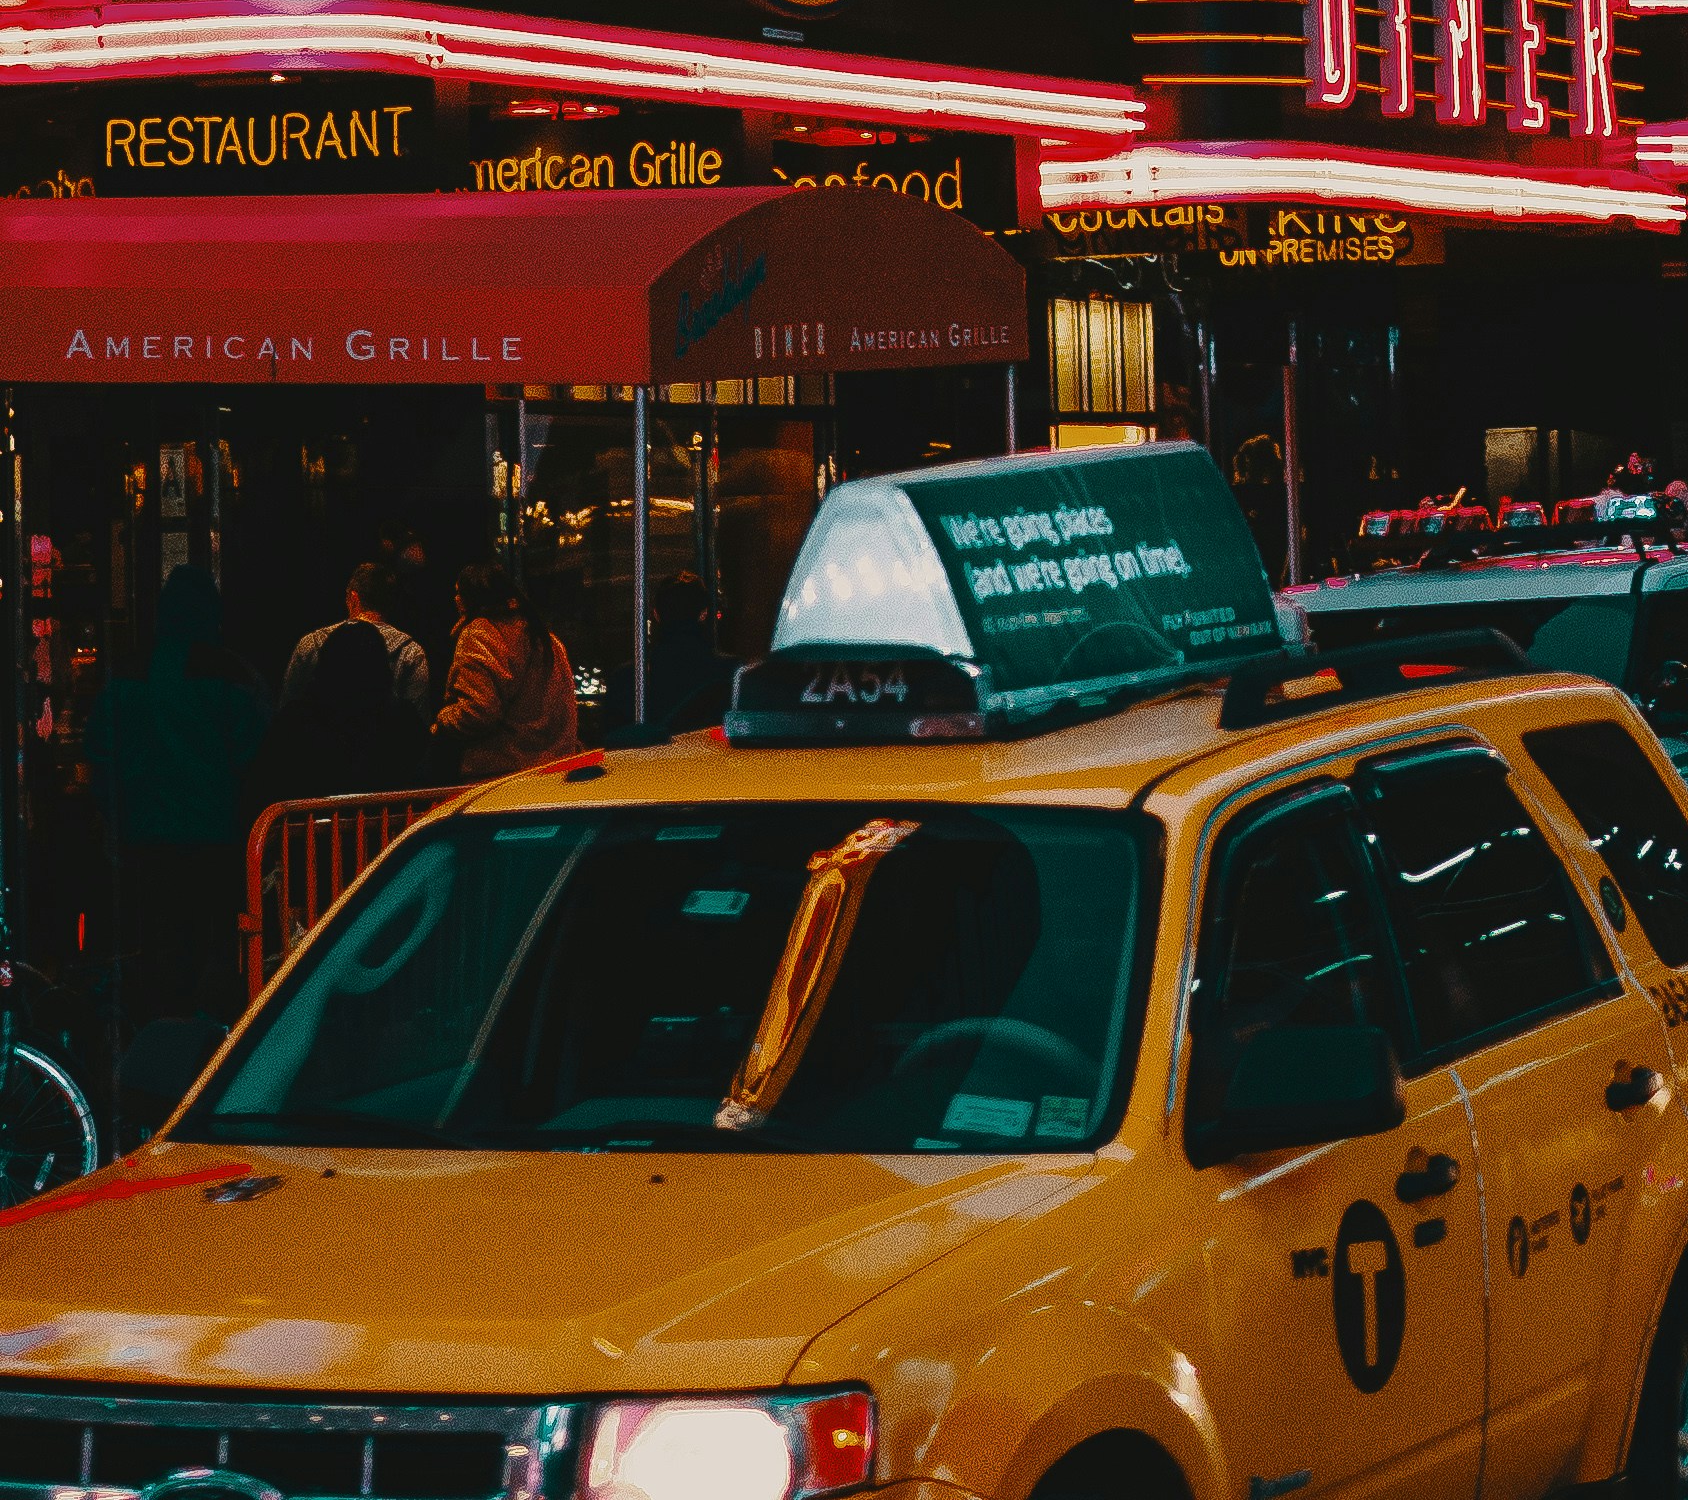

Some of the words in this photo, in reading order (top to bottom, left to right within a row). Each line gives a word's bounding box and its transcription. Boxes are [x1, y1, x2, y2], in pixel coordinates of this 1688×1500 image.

[106, 106, 413, 168] RESTAURANT
[629, 140, 724, 188] Grille
[772, 157, 963, 210] food
[1267, 236, 1396, 265] PREMISES
[65, 329, 314, 361] AMERICAN
[345, 329, 523, 361] GRILLE
[753, 322, 827, 360] DINER
[849, 325, 942, 354] AMERICAN
[947, 322, 1011, 349] GRILLE
[802, 658, 909, 704] 2A54
